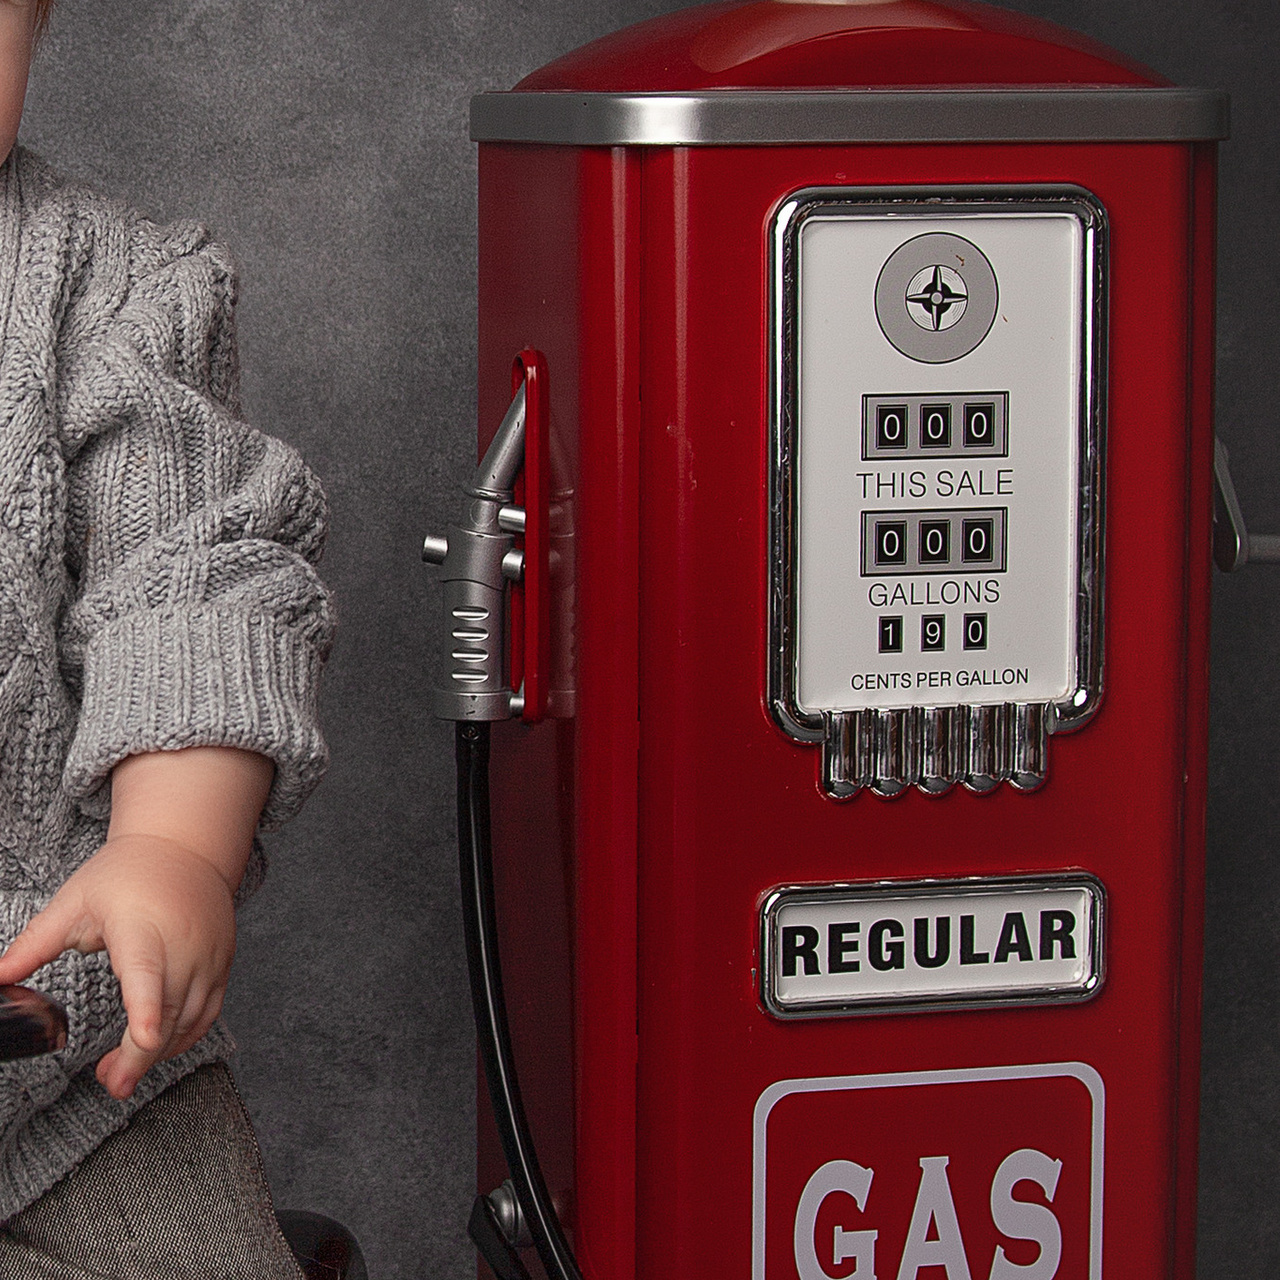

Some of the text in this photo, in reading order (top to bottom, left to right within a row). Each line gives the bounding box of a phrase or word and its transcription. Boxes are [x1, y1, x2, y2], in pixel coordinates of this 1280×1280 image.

[856, 470, 1014, 499] THIS SALE
[868, 580, 1000, 606] GALLONS
[851, 668, 1029, 691] CENTS PER GALLON
[781, 910, 1077, 977] REGULAR
